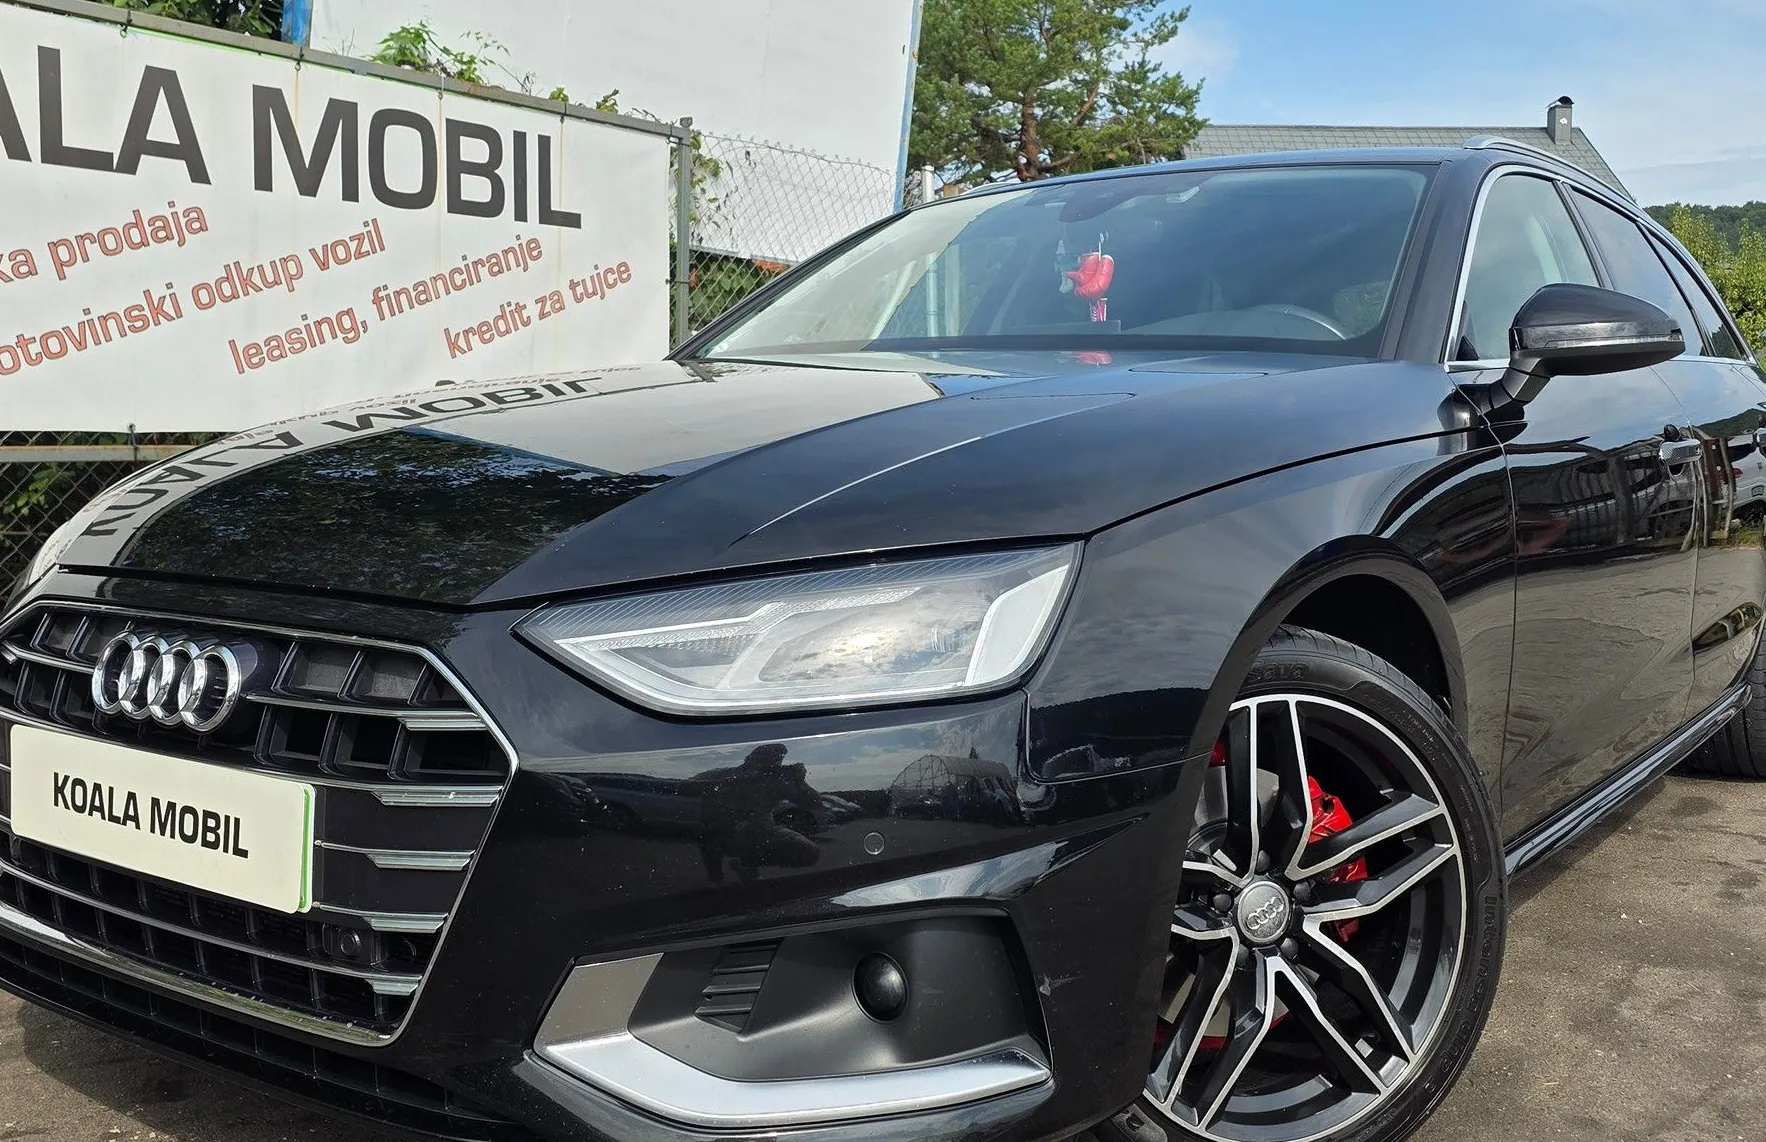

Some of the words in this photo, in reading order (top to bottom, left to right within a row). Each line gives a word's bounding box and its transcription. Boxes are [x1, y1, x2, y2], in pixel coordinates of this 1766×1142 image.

[252, 85, 582, 229] MOBIL
[47, 201, 208, 280] prodaja
[191, 254, 304, 310] odkup
[308, 218, 386, 271] vozil
[228, 308, 368, 374] leasing,
[372, 234, 543, 321] financiranje
[444, 302, 531, 359] kredit
[535, 289, 566, 321] za
[569, 261, 632, 304] tujce
[53, 772, 141, 830] KOALA
[150, 797, 249, 859] MOBIL
